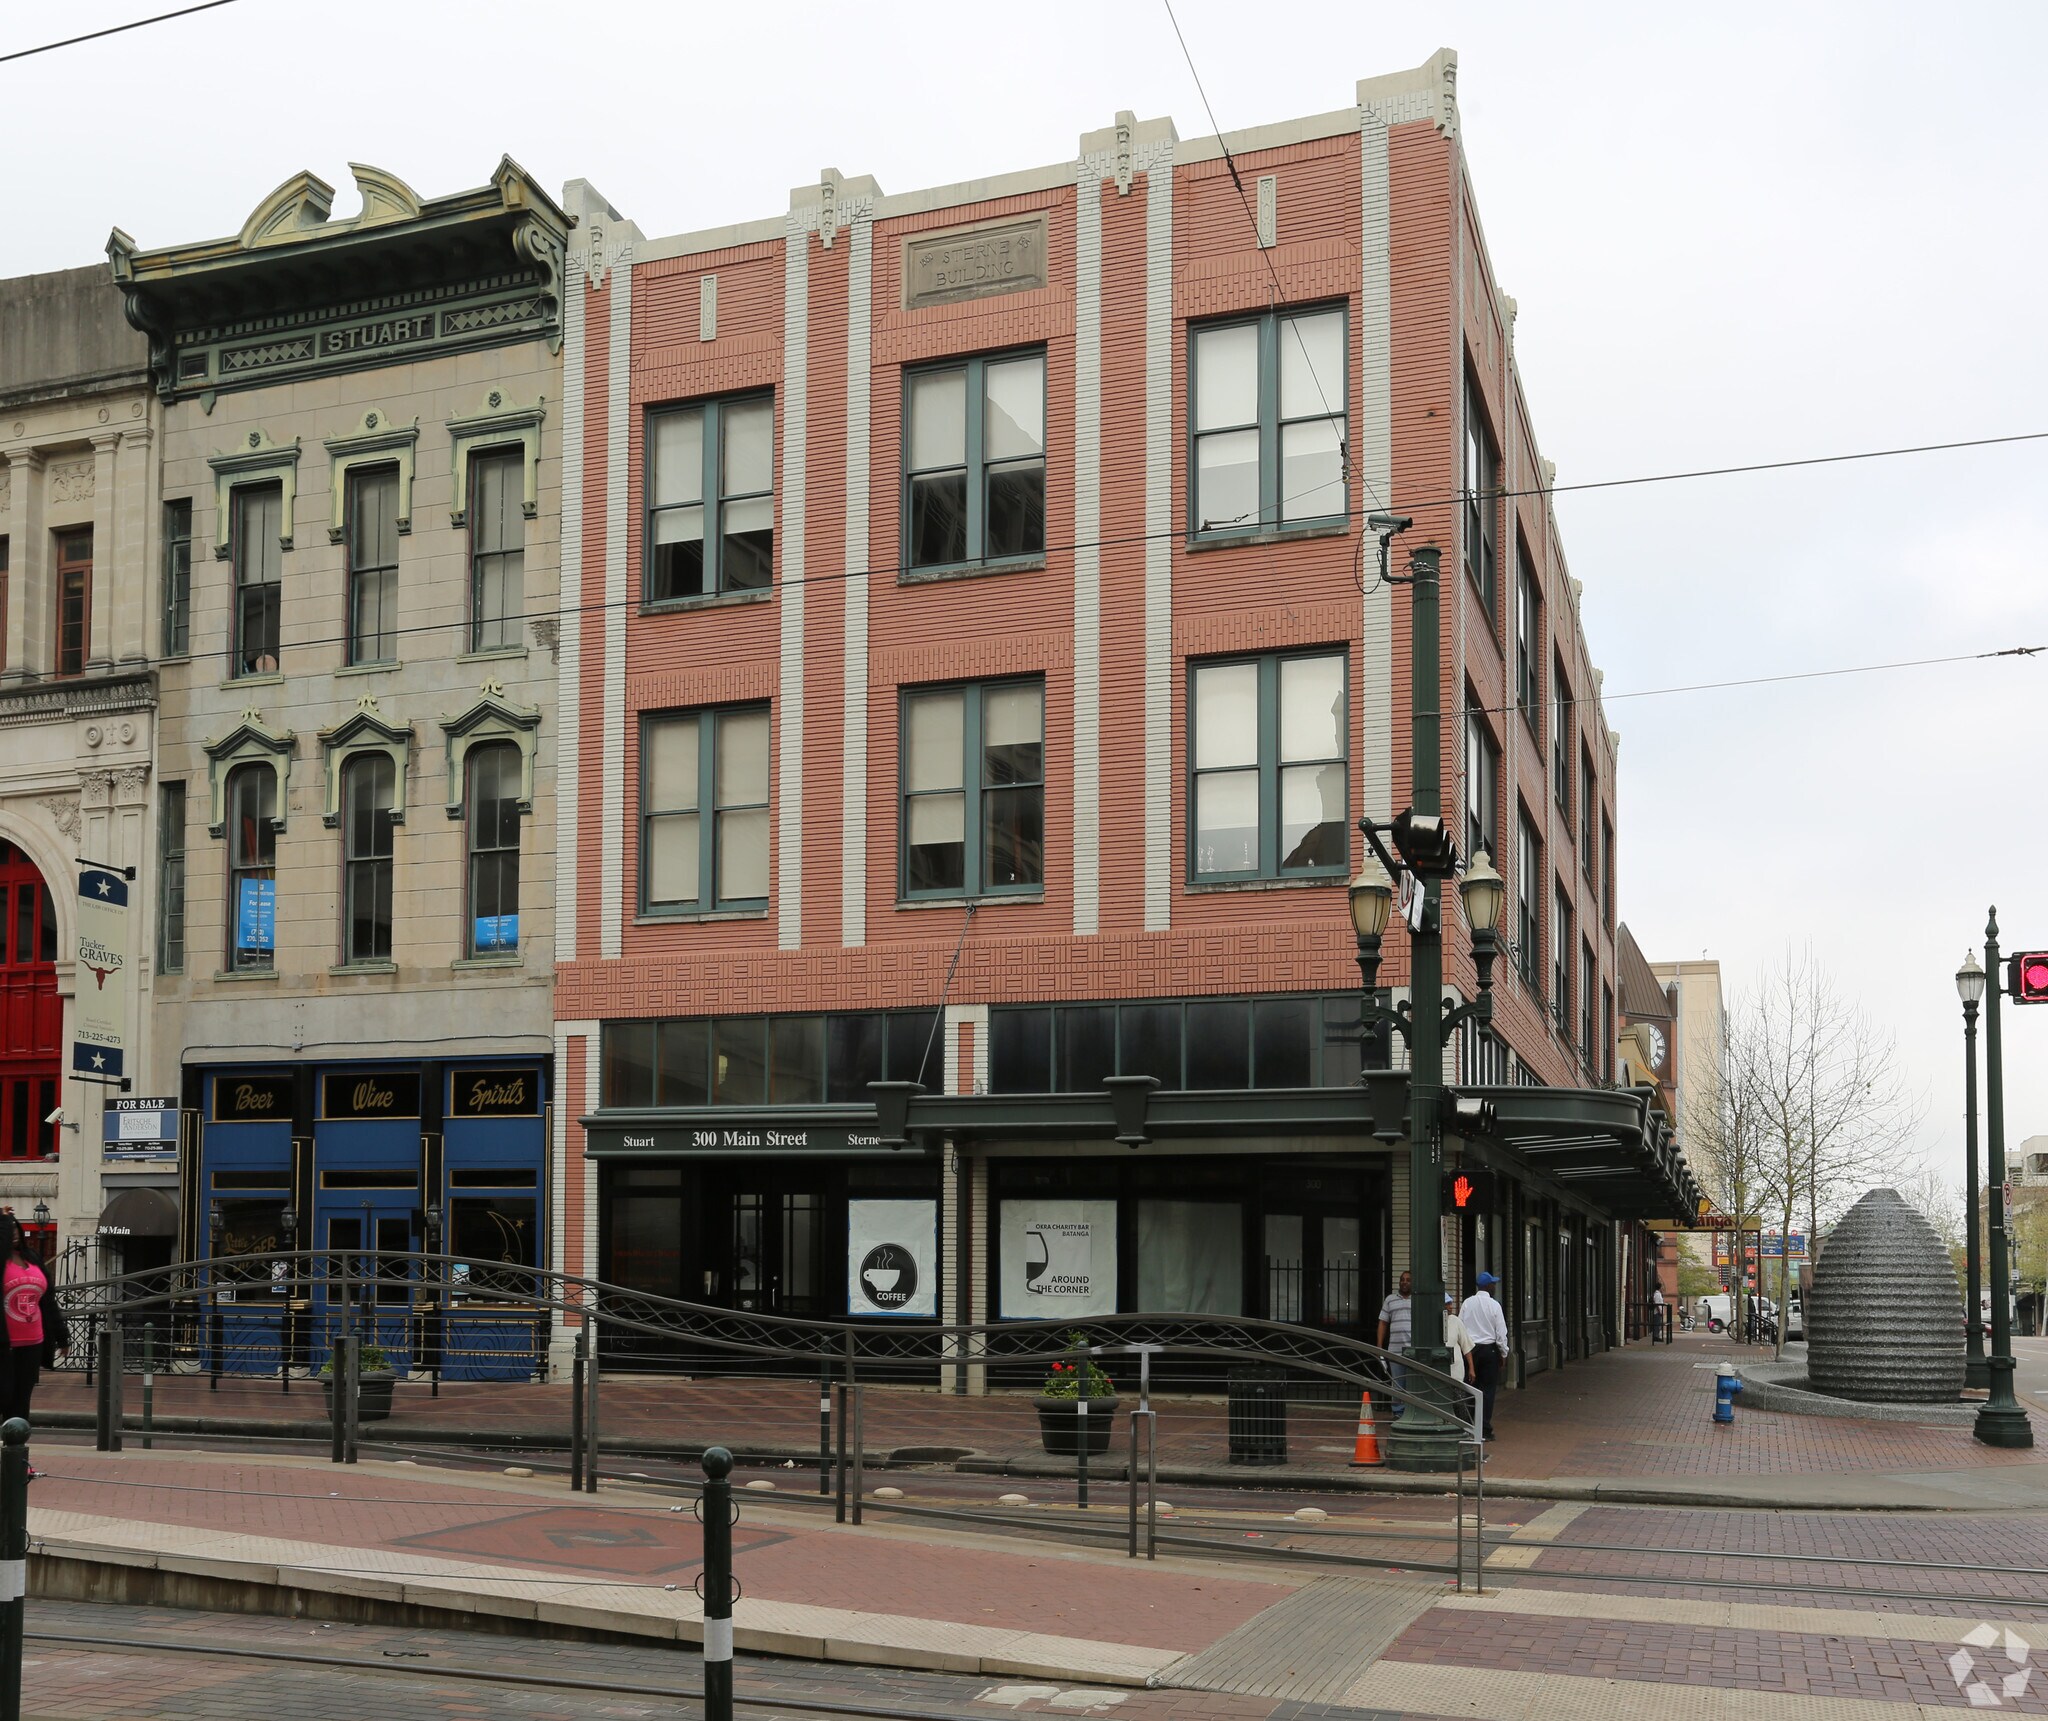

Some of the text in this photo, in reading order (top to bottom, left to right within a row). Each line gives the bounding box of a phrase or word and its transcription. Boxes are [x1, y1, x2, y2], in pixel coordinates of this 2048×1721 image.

[942, 240, 1010, 264] STERNE
[936, 261, 1014, 287] BUILDING
[328, 316, 427, 351] STUART
[80, 936, 105, 950] Tucker
[79, 947, 123, 965] GRAVES
[78, 1030, 121, 1044] 713-225-4273
[235, 1084, 274, 1111] Beer
[352, 1079, 394, 1111] Wine
[469, 1078, 525, 1111] Spirits
[116, 1099, 165, 1109] FOR SALE
[623, 1135, 655, 1147] Stuart
[692, 1130, 808, 1146] 300 Main Street
[847, 1134, 881, 1146] Sterne
[108, 1225, 131, 1235] Main
[1051, 1275, 1090, 1284] AROUND
[1036, 1284, 1090, 1294] THE CORNER
[876, 1292, 907, 1302] COFFEE
